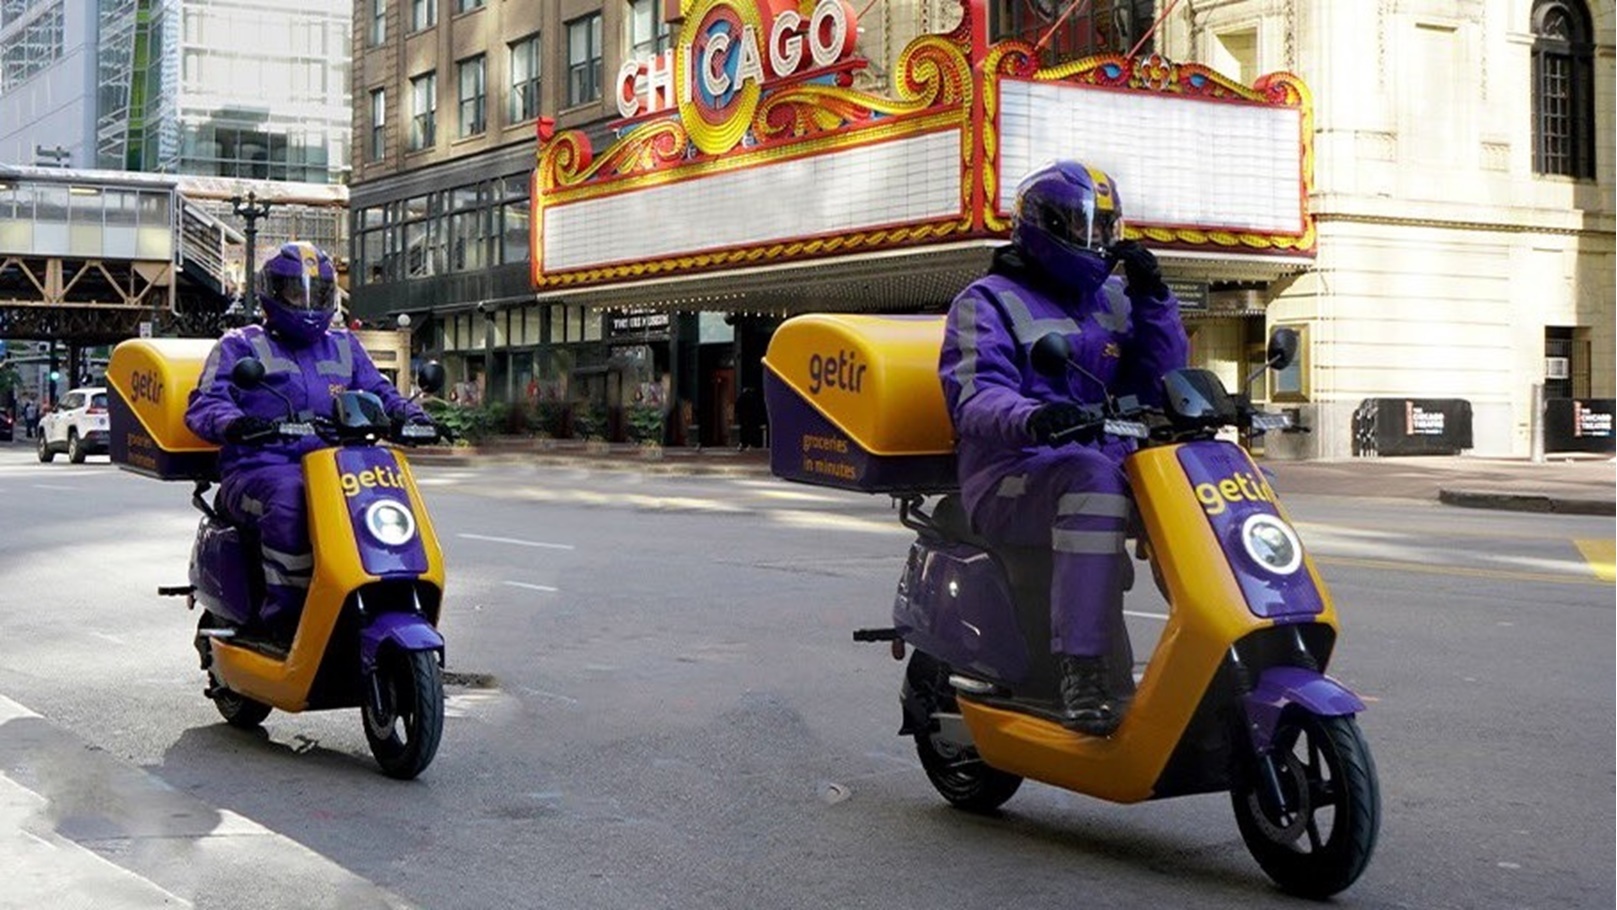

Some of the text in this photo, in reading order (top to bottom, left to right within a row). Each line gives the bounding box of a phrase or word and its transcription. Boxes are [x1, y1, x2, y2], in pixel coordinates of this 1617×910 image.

[616, 0, 847, 118] CHICAGO
[131, 369, 163, 404] getir
[809, 349, 866, 395] getir
[803, 434, 848, 454] groceries
[341, 465, 405, 497] getir
[804, 459, 857, 480] in minutes
